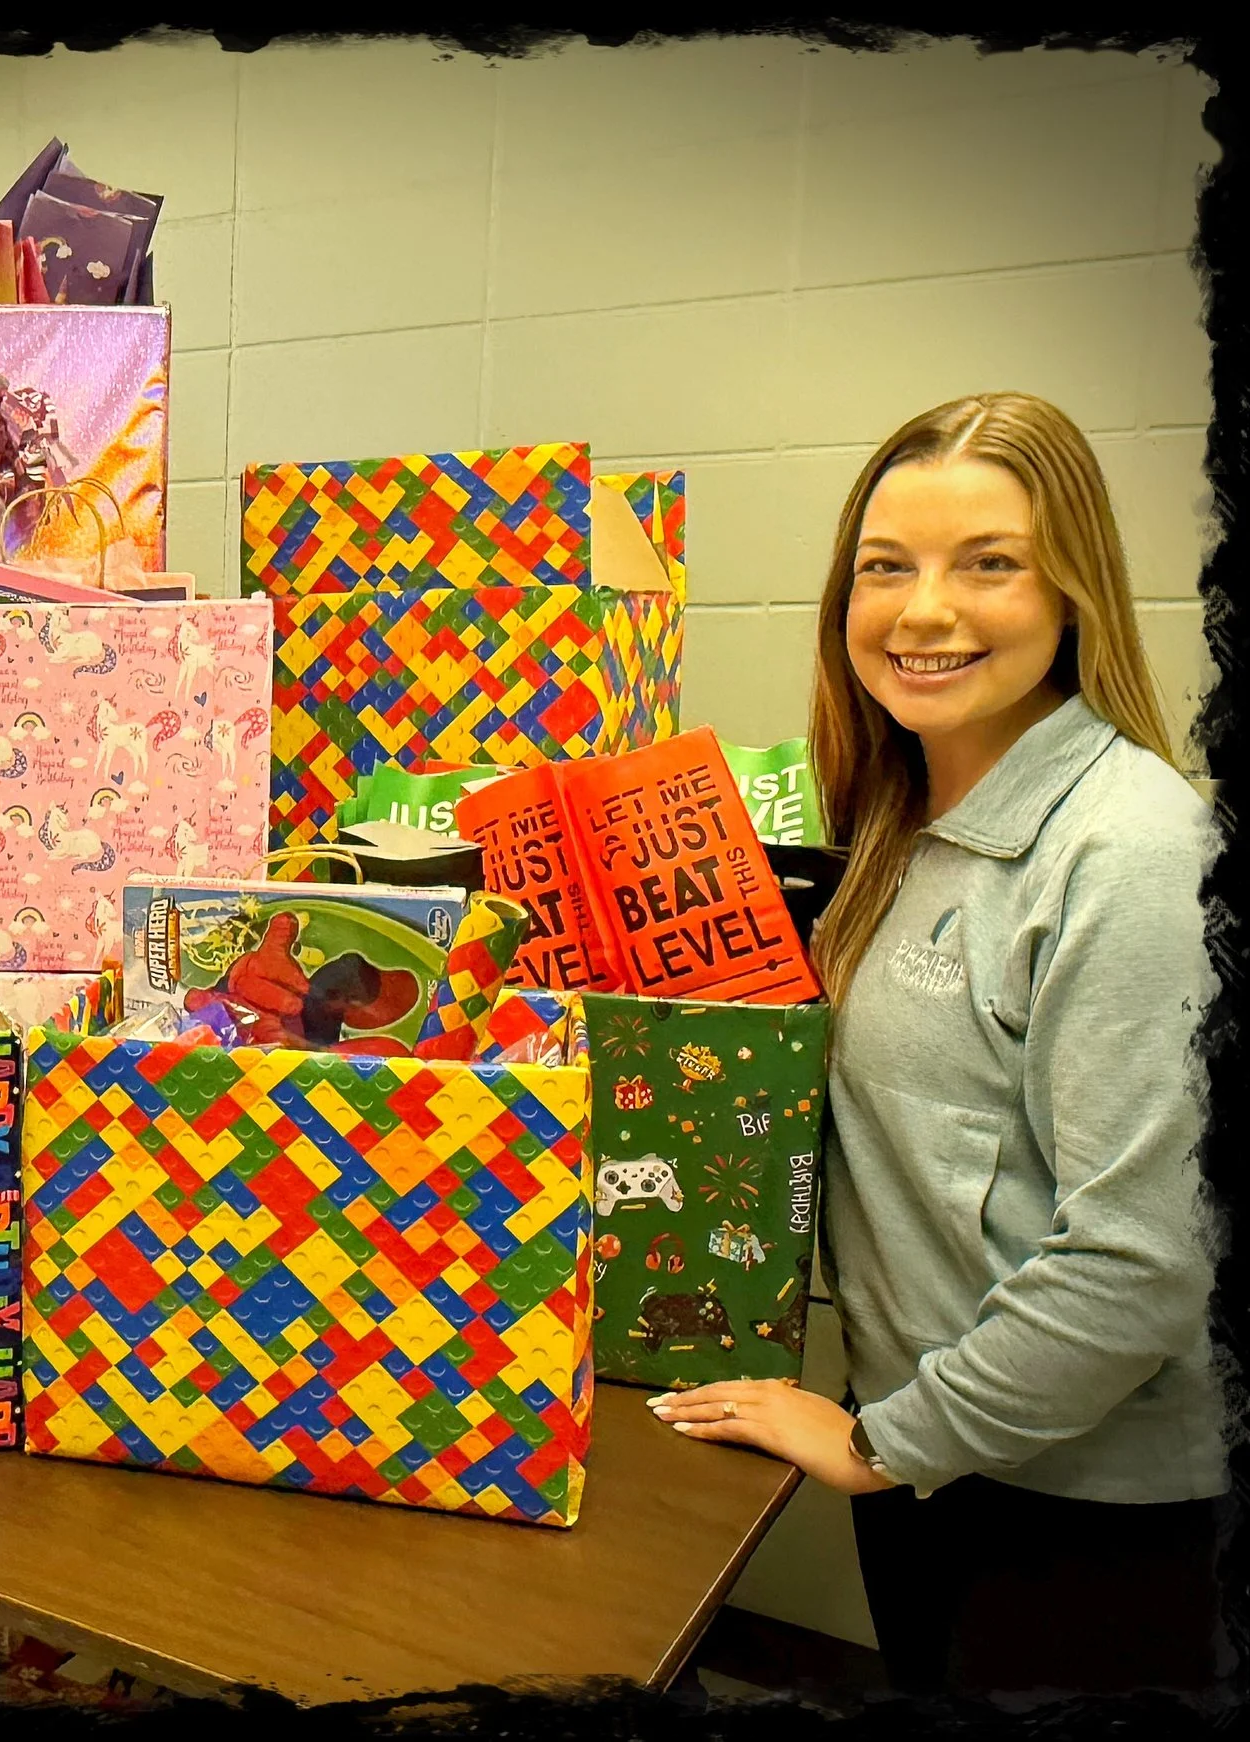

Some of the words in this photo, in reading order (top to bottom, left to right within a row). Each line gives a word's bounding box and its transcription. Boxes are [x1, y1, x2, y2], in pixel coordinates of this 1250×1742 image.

[389, 801, 454, 832] JUS
[508, 799, 559, 838] ME
[586, 787, 643, 833] LET
[657, 765, 716, 805] ME
[631, 795, 727, 869] JUST
[489, 830, 569, 894] JUST
[727, 846, 759, 900] THIS
[148, 899, 168, 939] HERO
[520, 888, 565, 945] AT
[613, 855, 724, 933] BEAT
[148, 941, 170, 991] SUPER
[504, 939, 607, 990] EVEL
[630, 906, 782, 988] LEVEL
